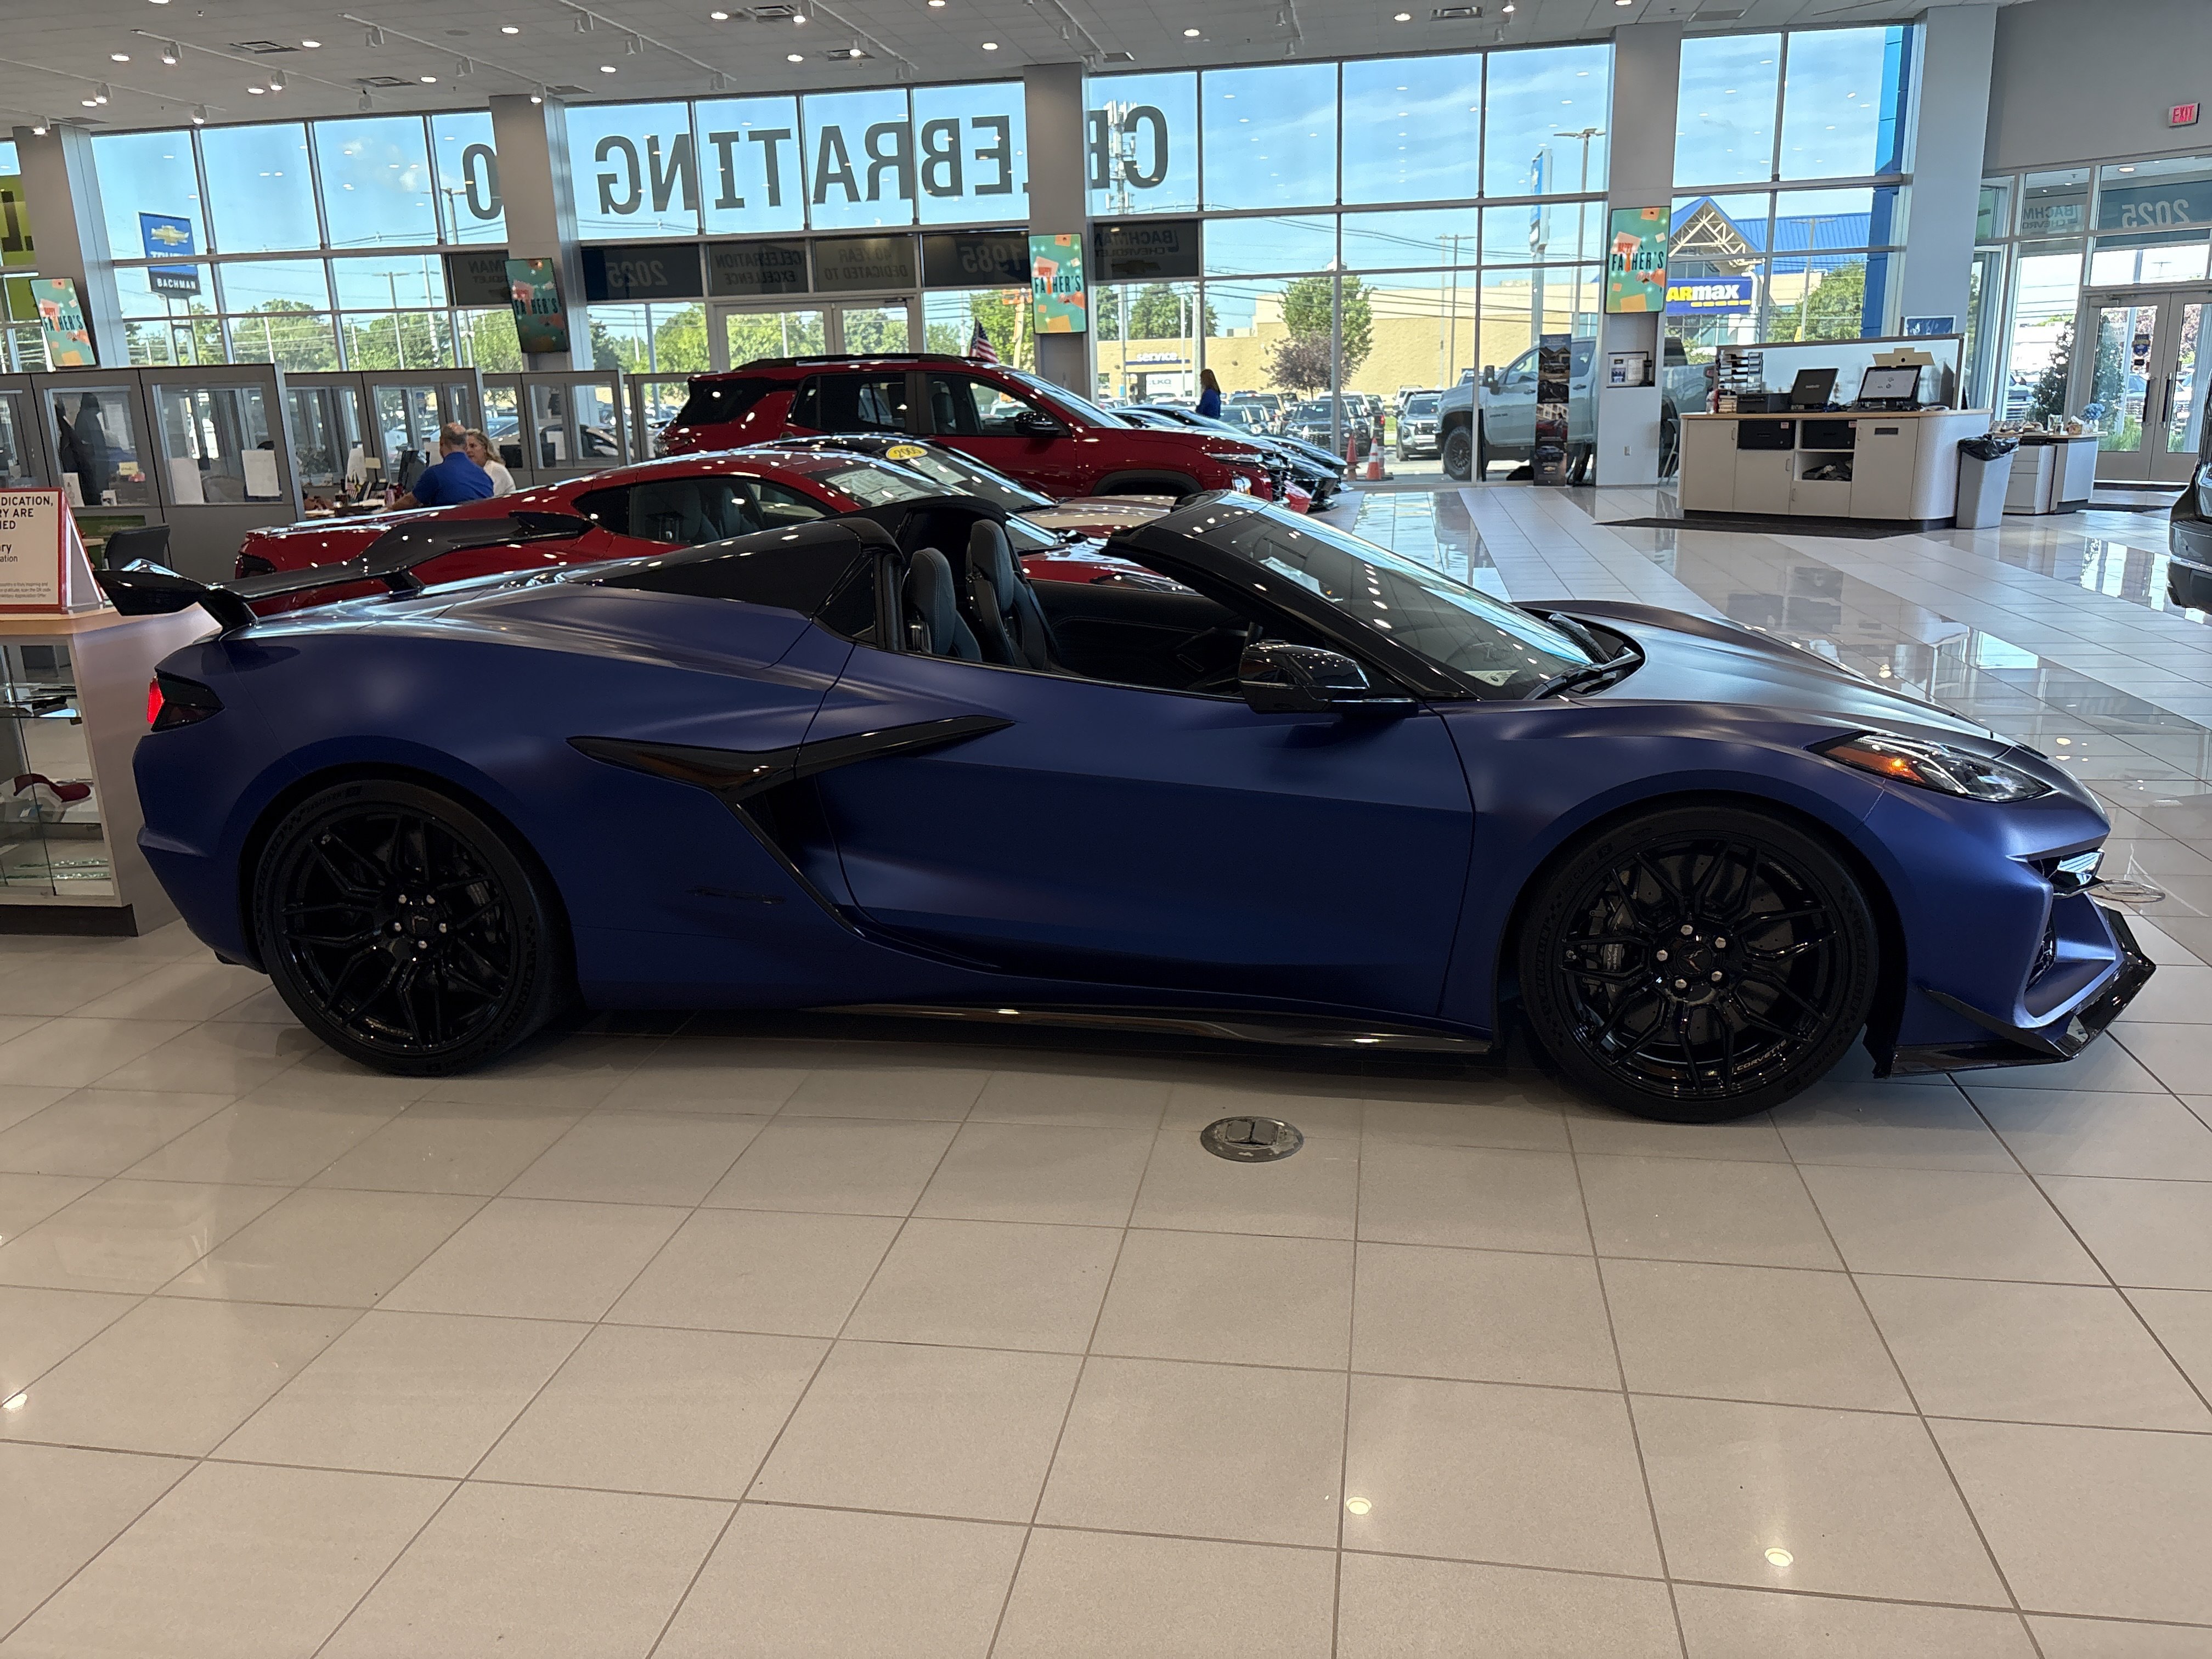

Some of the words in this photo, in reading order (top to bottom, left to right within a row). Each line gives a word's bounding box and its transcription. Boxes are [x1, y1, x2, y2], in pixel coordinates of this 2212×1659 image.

[2172, 105, 2194, 123] EXIT
[157, 278, 196, 290] BACHMAN
[1136, 353, 1178, 362] service
[13, 508, 34, 517] ARE
[1736, 1039, 1786, 1071] CORVETTE
